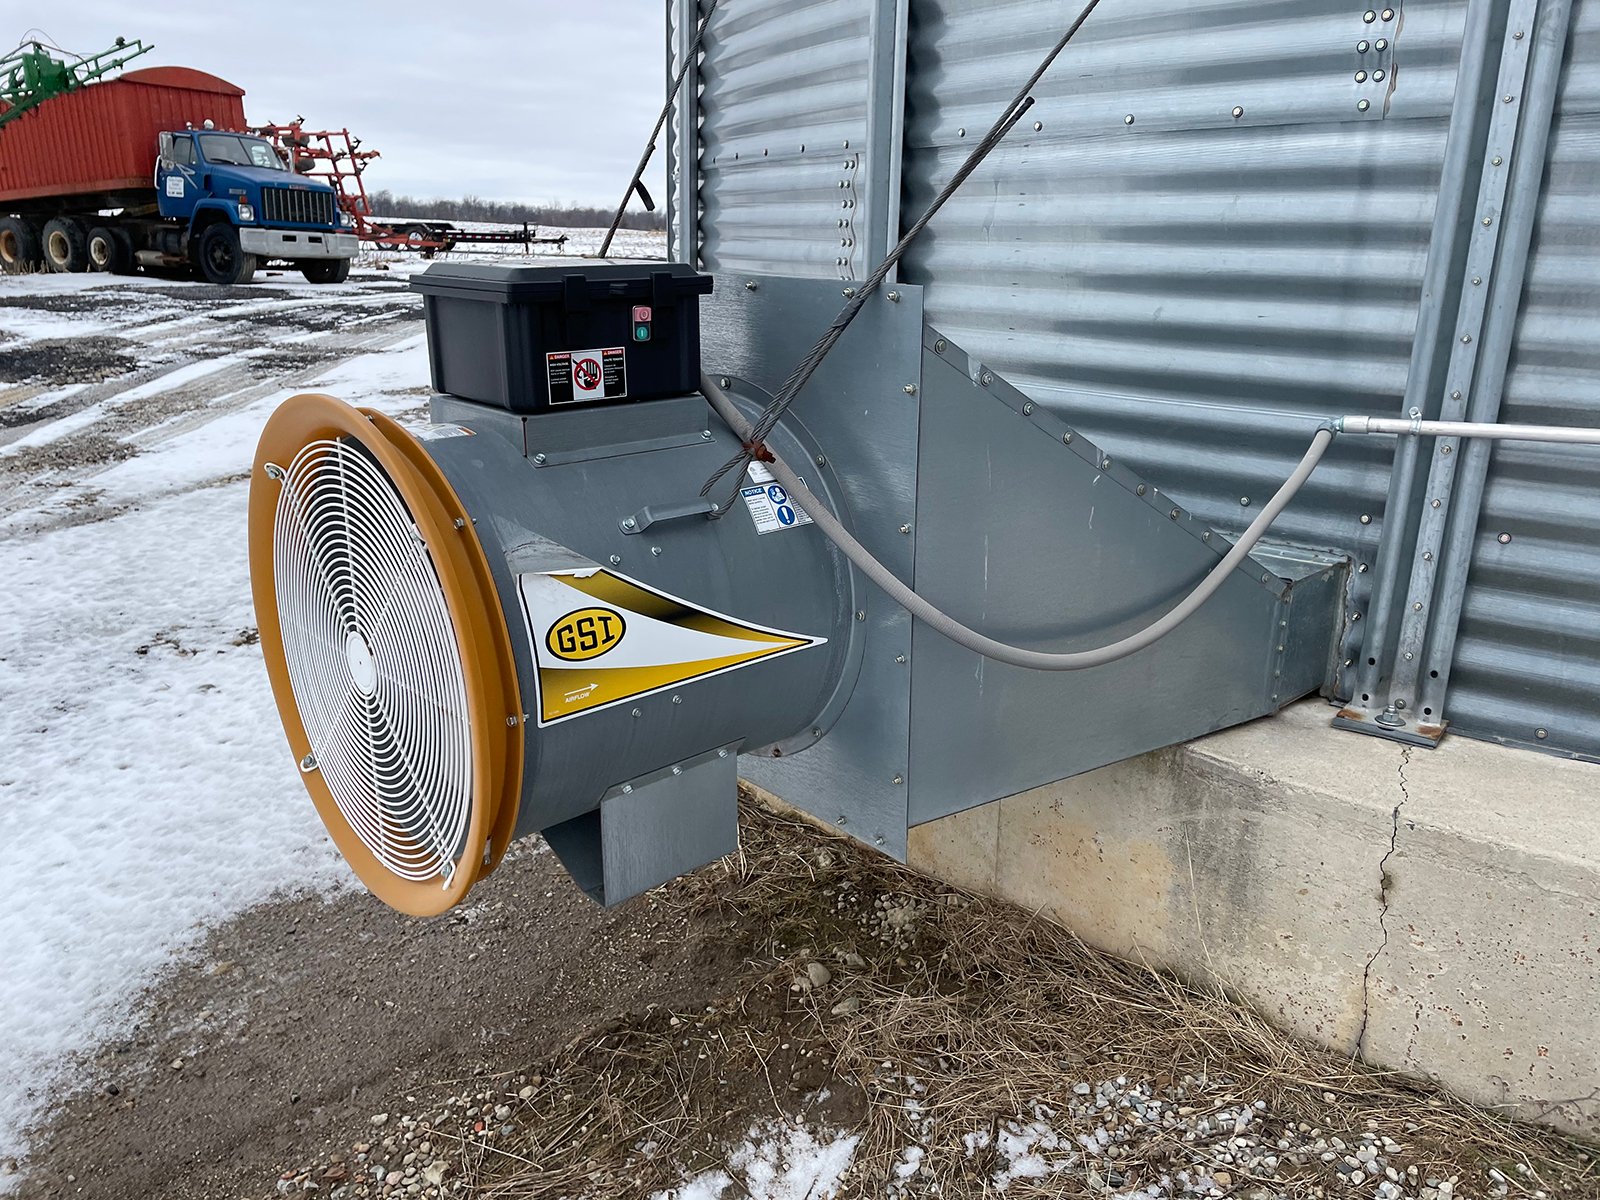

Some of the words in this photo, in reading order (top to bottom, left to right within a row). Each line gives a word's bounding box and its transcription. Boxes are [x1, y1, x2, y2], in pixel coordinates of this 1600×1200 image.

[745, 488, 763, 496] NOTICE
[556, 616, 616, 653] GSI
[565, 692, 590, 703] AIRFLOW
